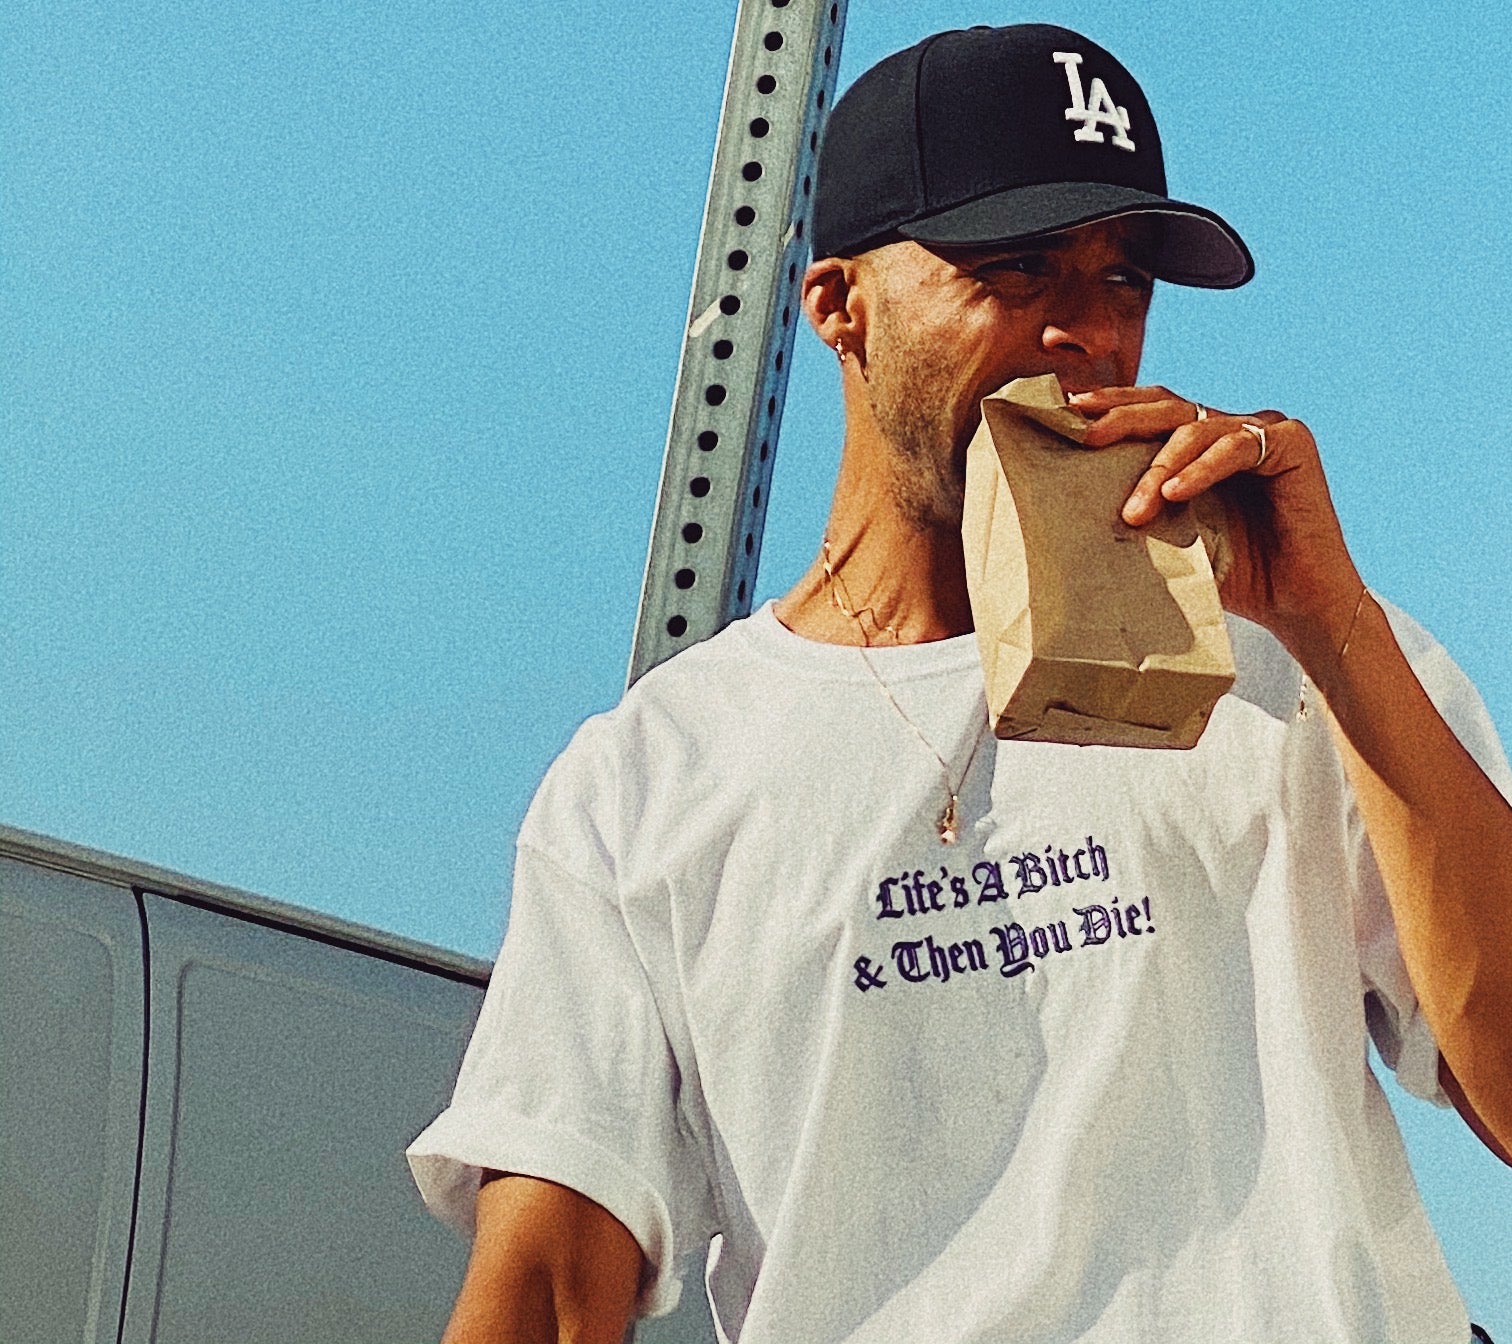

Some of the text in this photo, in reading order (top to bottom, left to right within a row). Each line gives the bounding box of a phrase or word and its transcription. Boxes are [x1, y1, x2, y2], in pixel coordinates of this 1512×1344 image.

[1053, 52, 1136, 152] LA
[876, 835, 1110, 920] Life's A Bitch
[853, 896, 1156, 992] & Then You Die!
